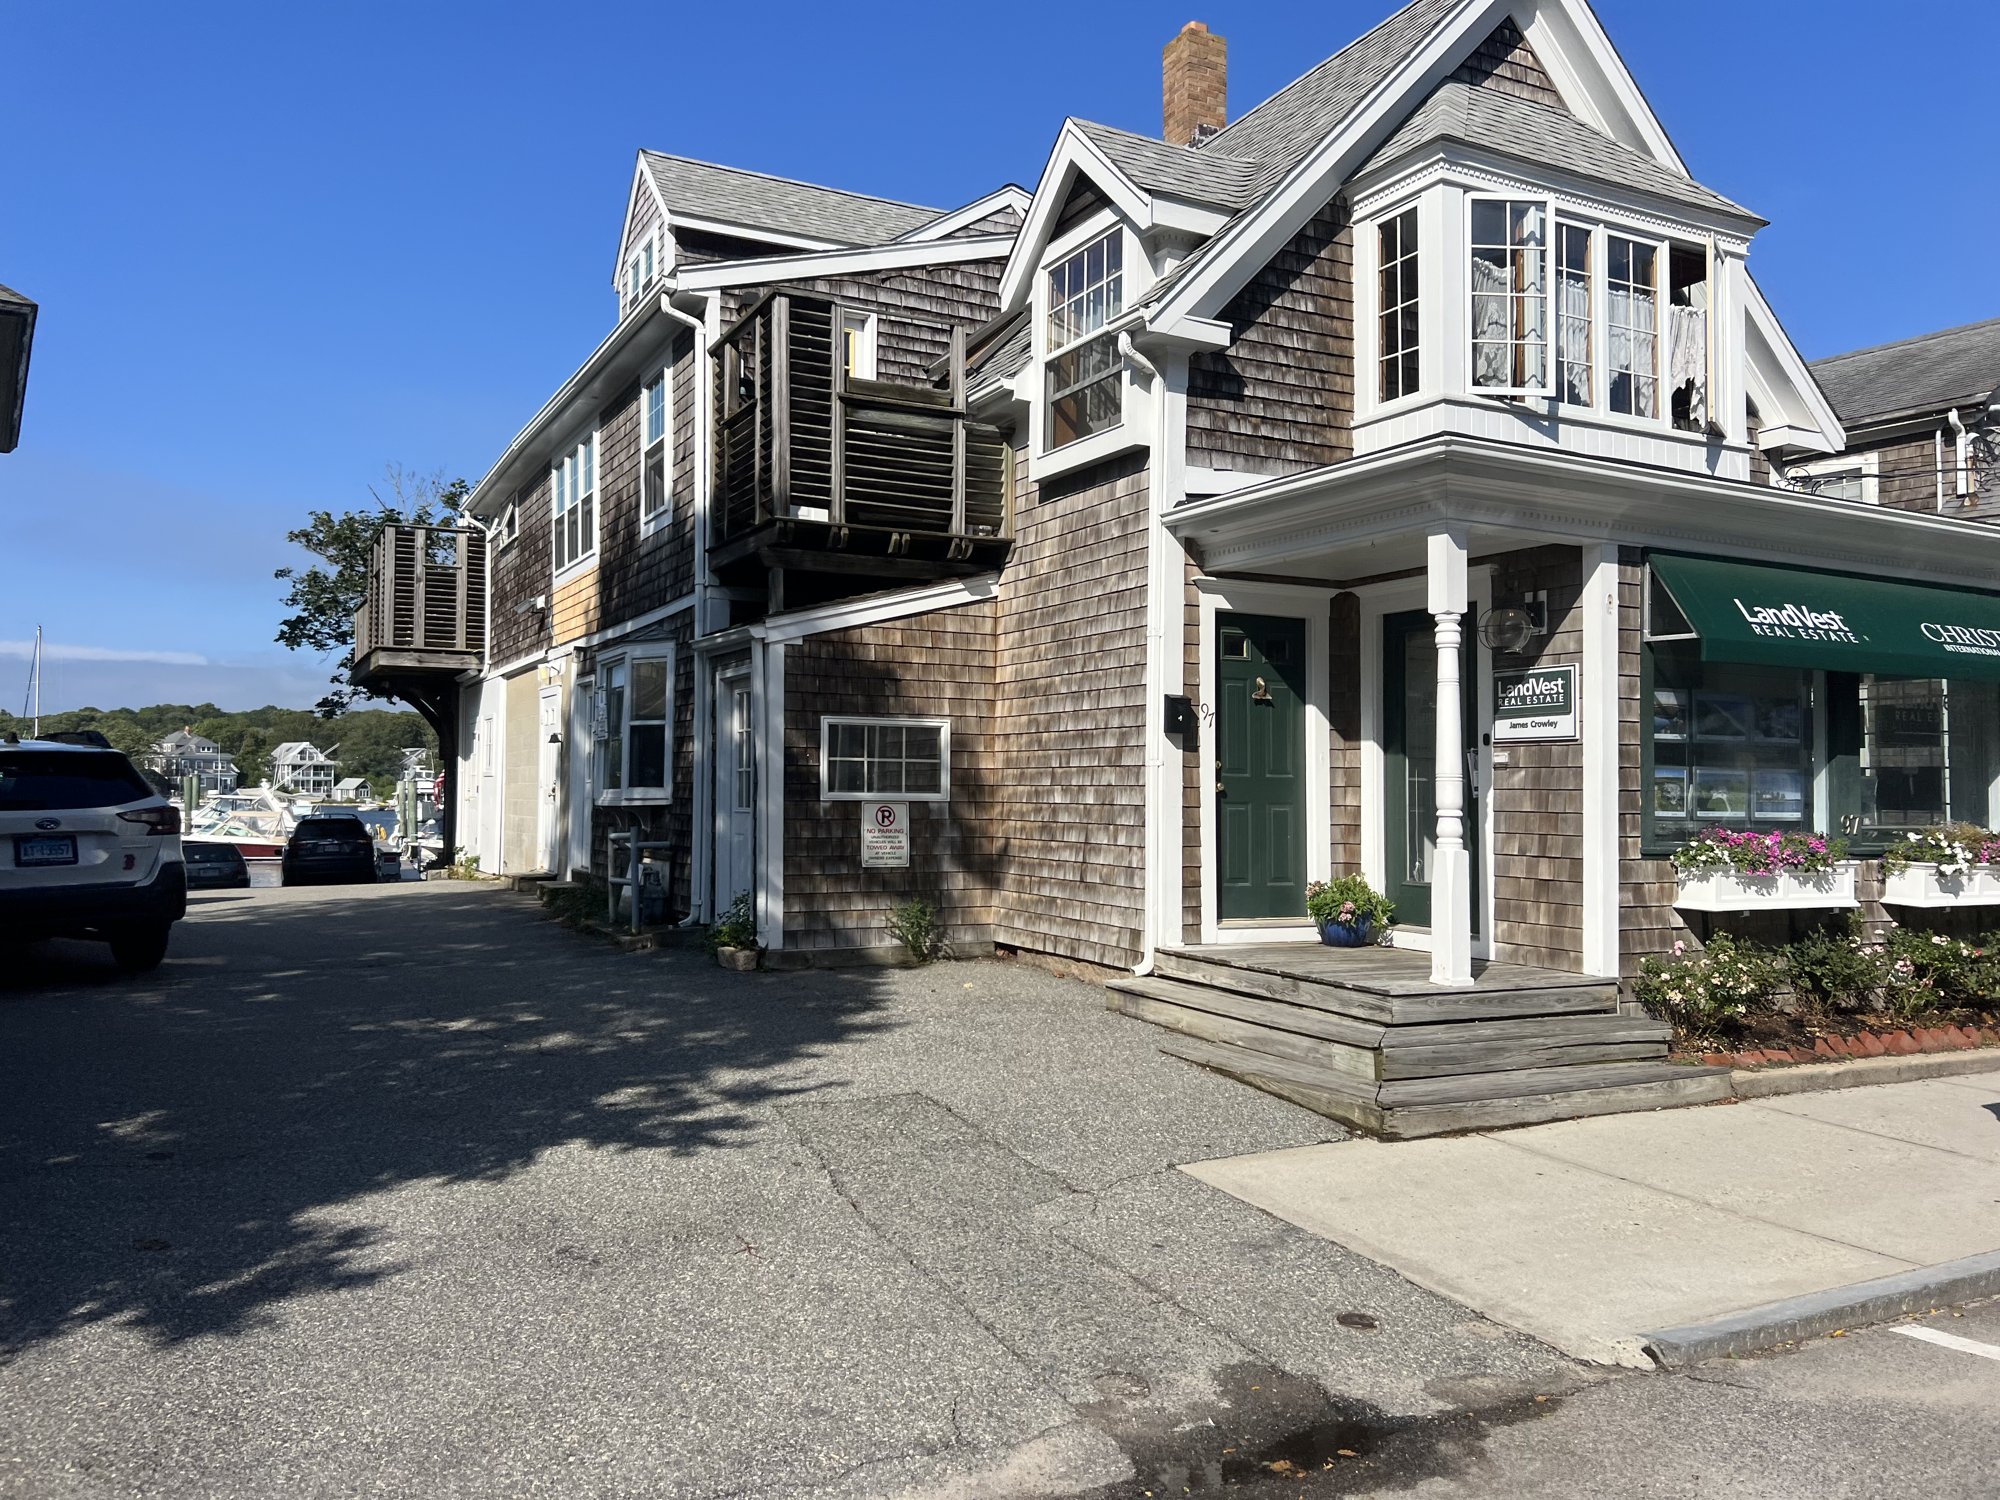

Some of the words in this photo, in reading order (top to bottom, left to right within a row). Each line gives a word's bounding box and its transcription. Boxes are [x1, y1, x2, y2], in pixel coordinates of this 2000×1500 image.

[1733, 598, 1850, 632] LandVest
[1751, 623, 1796, 638] REAL
[1797, 627, 1860, 644] ESTATE
[1498, 677, 1564, 697] LandVest
[1498, 698, 1522, 706] REAL
[1526, 694, 1564, 704] ESTATE
[1201, 703, 1215, 728] 97
[1509, 721, 1529, 729] James
[1530, 719, 1558, 729] Crowley
